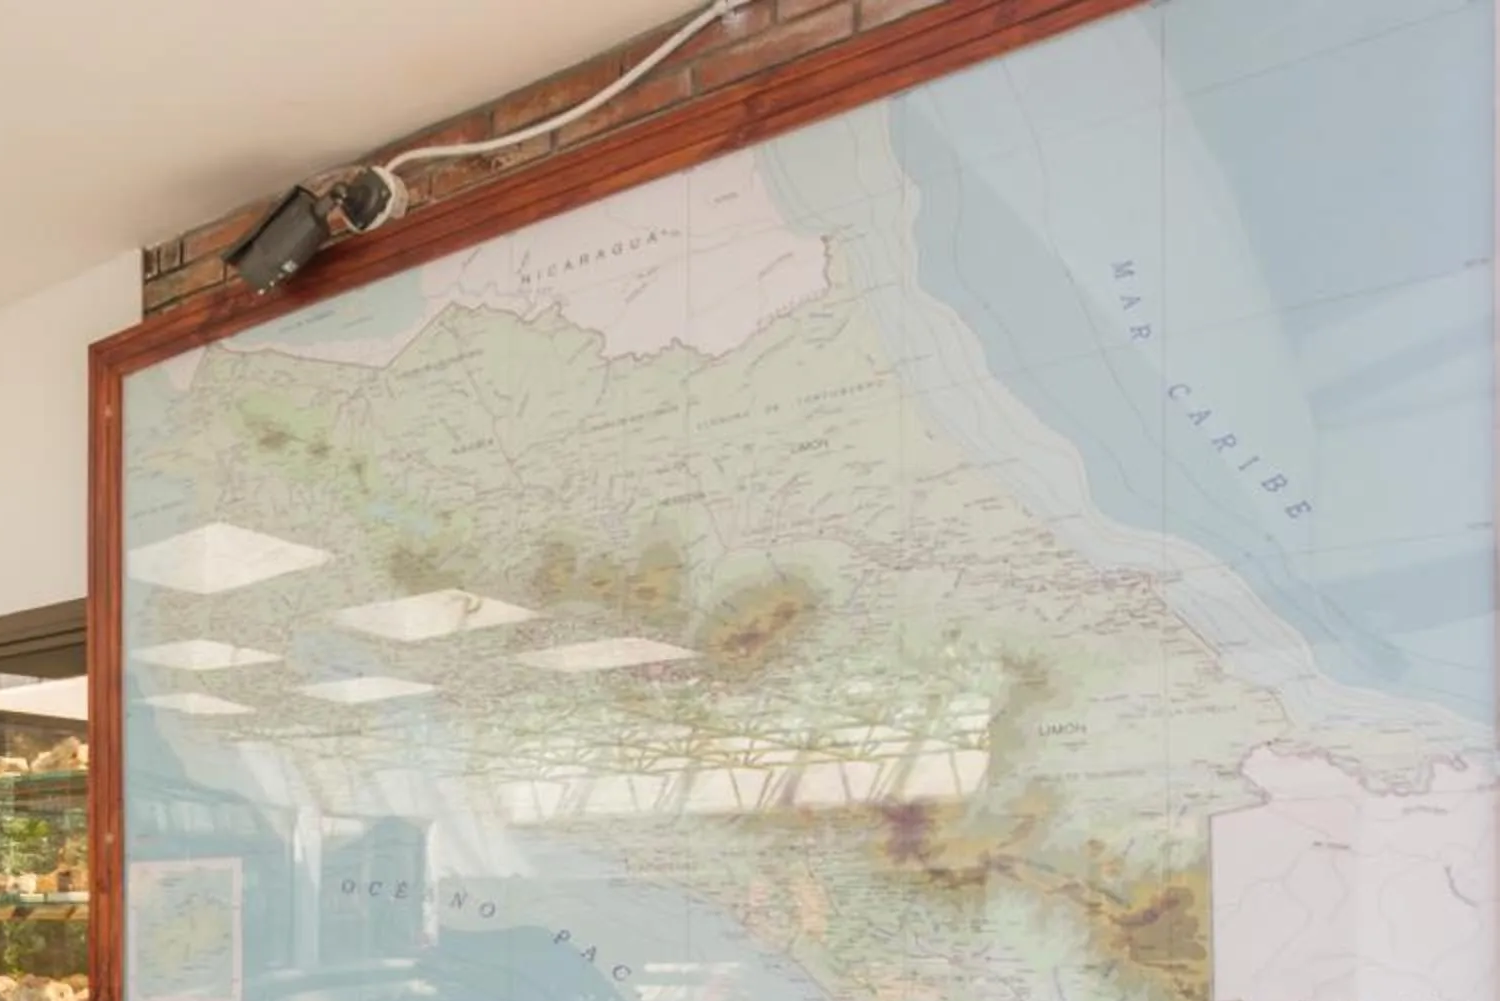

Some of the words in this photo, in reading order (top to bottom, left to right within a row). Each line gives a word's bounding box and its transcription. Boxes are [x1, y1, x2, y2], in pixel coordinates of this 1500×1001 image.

[520, 230, 658, 285] NICARAGUA
[1110, 259, 1152, 341] MAR
[1167, 382, 1312, 520] CARIBE
